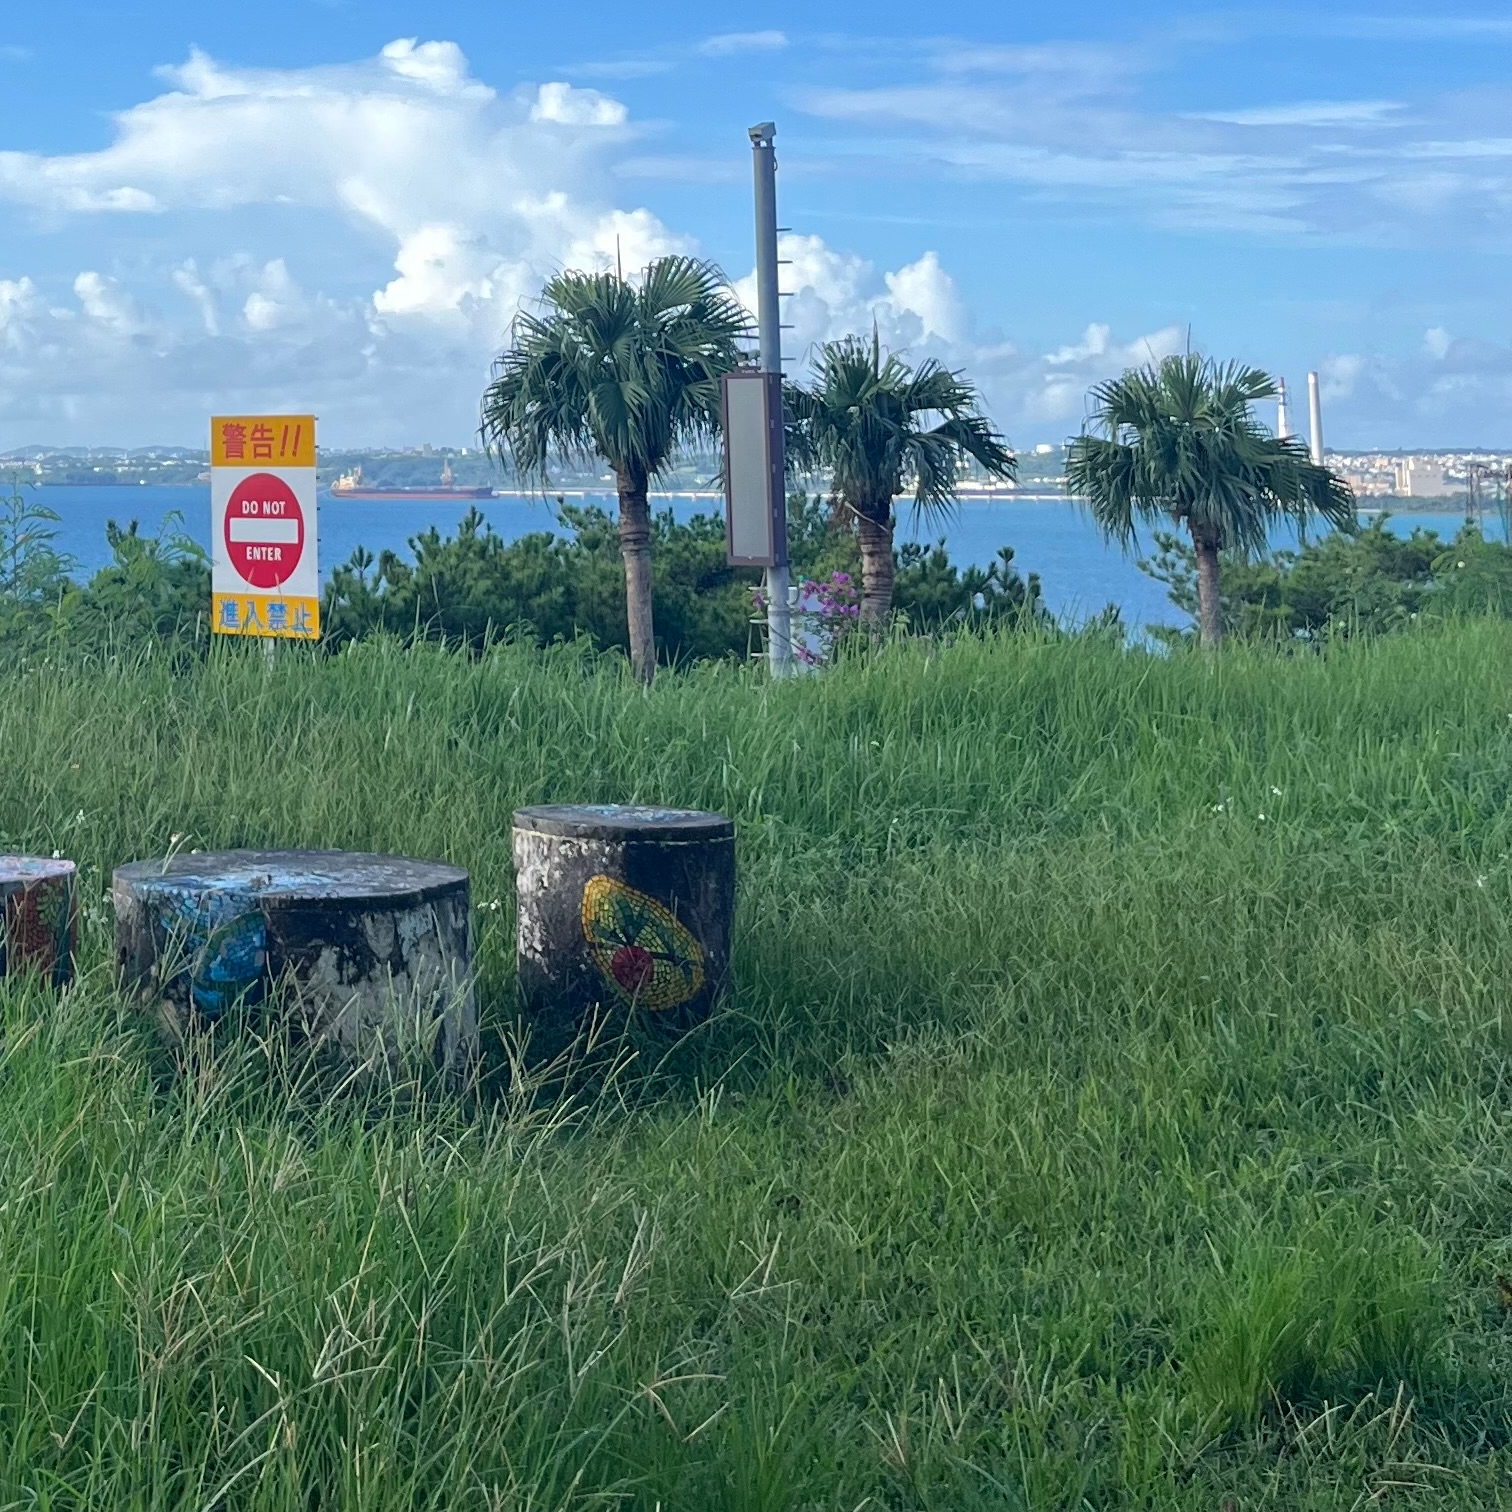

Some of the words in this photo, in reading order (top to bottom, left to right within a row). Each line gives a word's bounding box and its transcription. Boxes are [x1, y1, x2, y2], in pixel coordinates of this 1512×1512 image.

[241, 500, 259, 515] DO
[262, 500, 286, 515] NOT
[246, 546, 282, 561] ENTER
